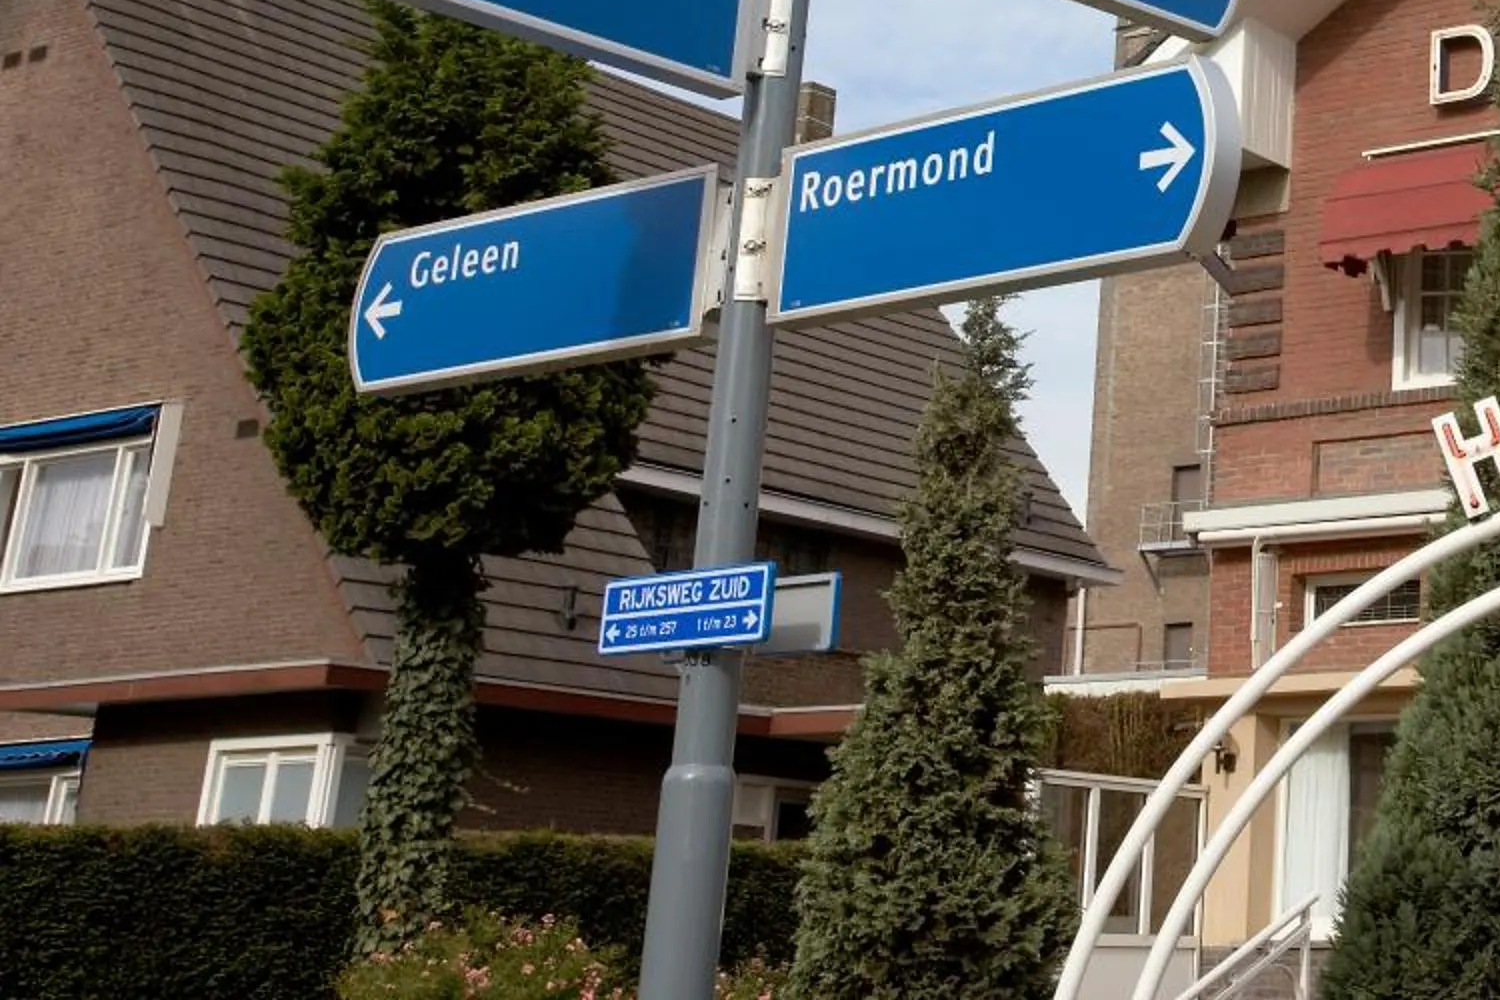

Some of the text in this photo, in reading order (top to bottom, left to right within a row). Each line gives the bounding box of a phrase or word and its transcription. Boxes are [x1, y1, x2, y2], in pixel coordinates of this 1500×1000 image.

[799, 130, 996, 213] Roermond
[410, 240, 521, 289] Geleen
[619, 575, 750, 611] RIJKSWEG ZUID
[625, 624, 639, 639] 25
[640, 623, 657, 637] t/m
[703, 617, 721, 631] t/m
[723, 615, 737, 629] 23
